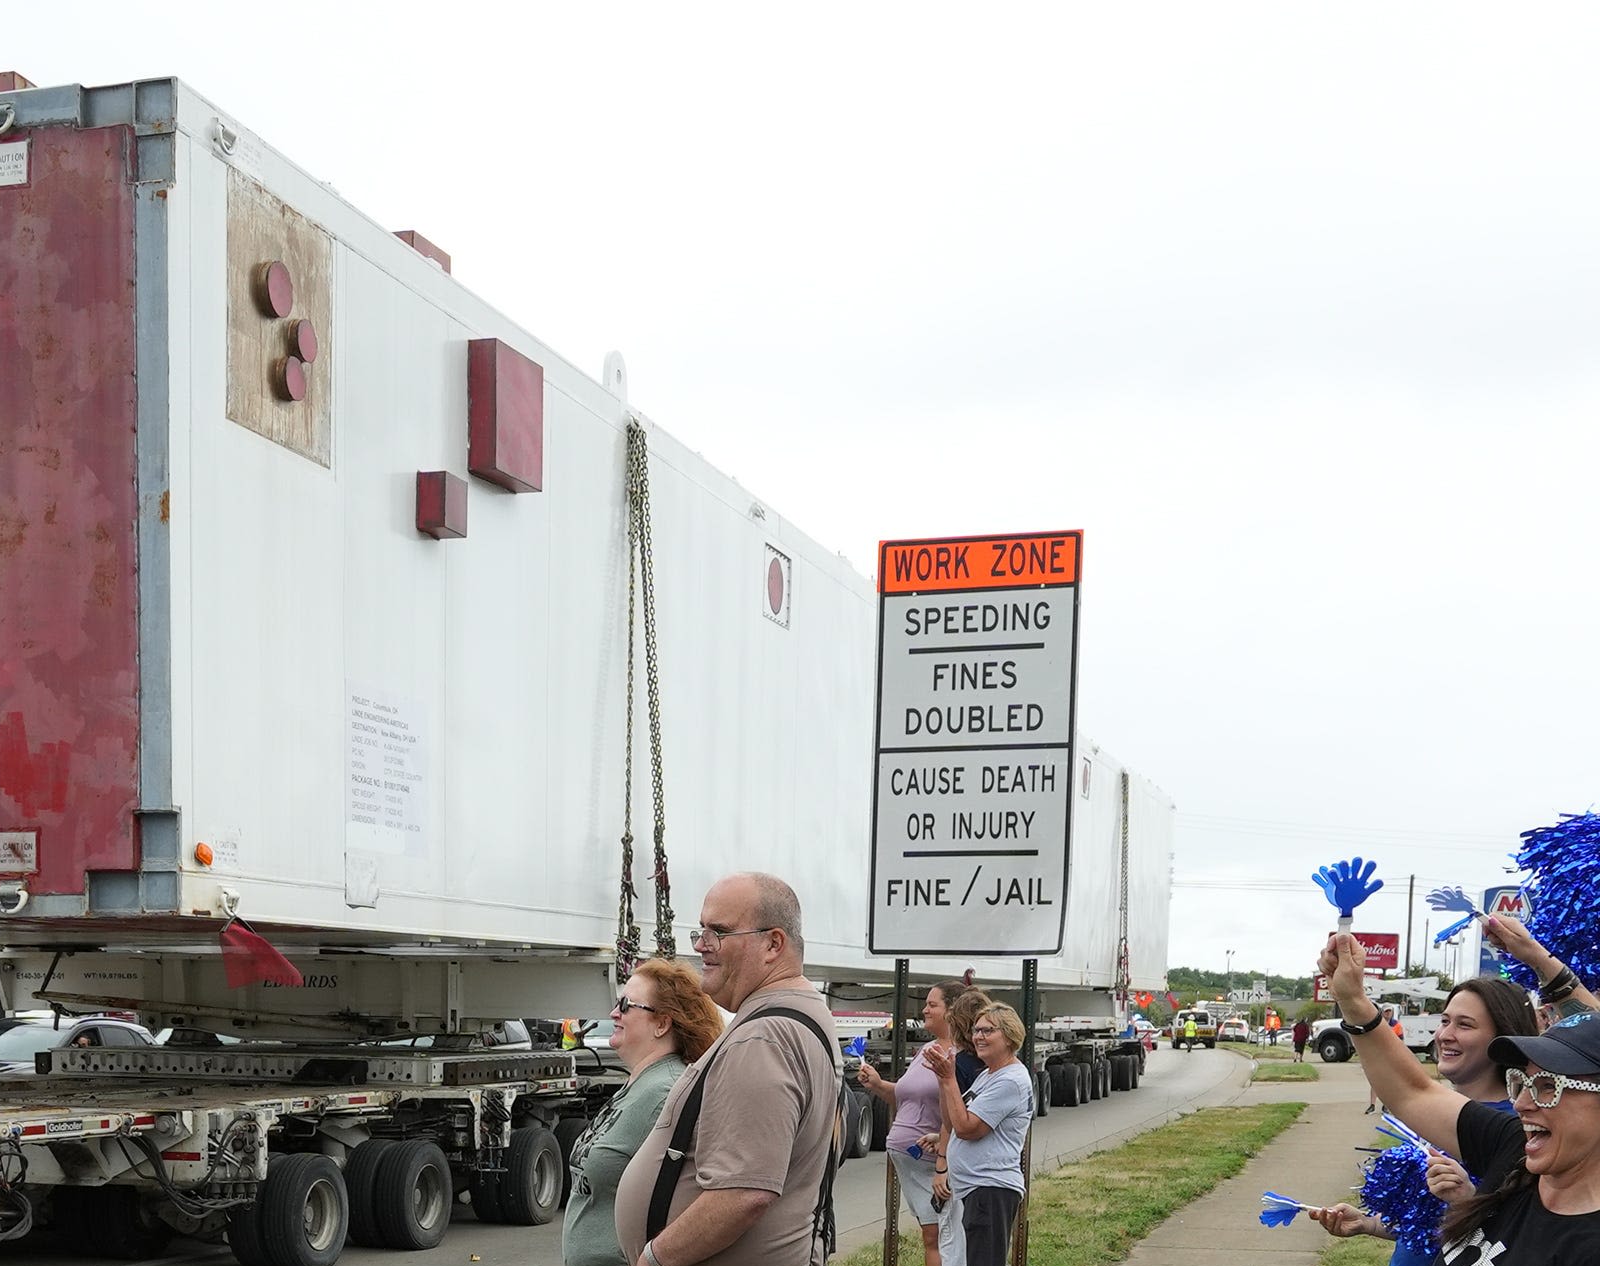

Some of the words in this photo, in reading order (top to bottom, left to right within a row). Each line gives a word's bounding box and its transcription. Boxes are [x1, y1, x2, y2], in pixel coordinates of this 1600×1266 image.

[894, 545, 971, 582] WORK
[991, 540, 1066, 576] ZONE
[905, 601, 1052, 637] SPEEDING
[932, 661, 1018, 691] FINES
[905, 704, 1044, 735] DOUBLED
[891, 768, 964, 796] CAUSE
[982, 765, 1056, 793] DEATH
[907, 813, 935, 840] OR
[952, 811, 1036, 840] INJURY
[887, 879, 951, 906] FINE
[985, 878, 1052, 905] JAIL
[263, 975, 338, 988] EDARDS
[48, 1121, 82, 1133] Goldhofer
